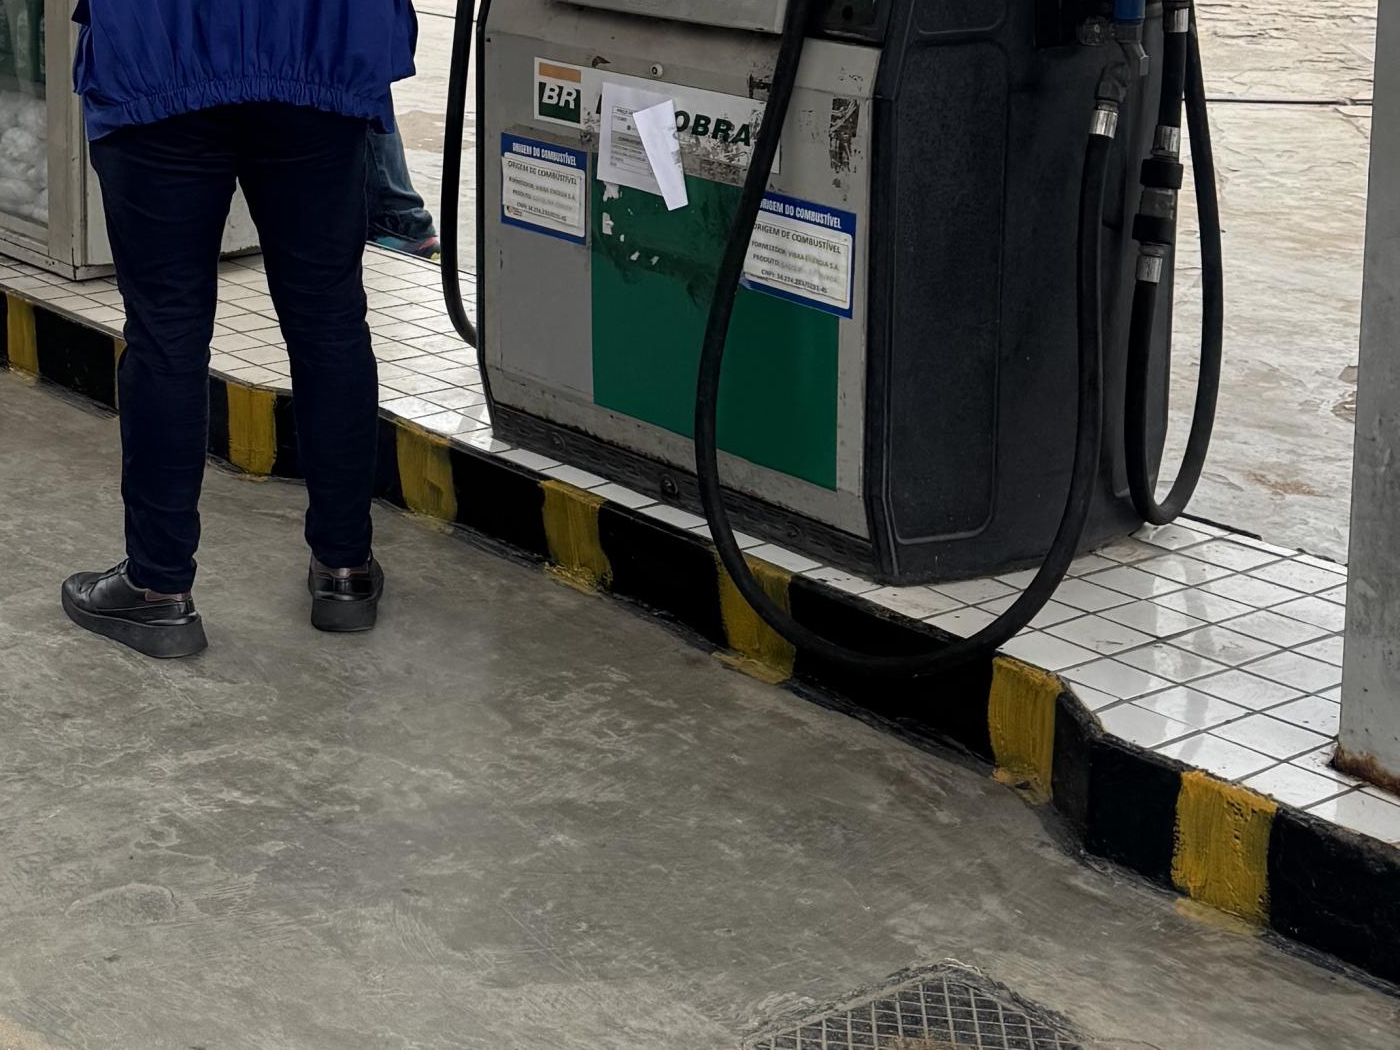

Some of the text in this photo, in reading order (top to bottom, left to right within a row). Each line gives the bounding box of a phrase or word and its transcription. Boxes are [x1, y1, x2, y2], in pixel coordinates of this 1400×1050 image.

[542, 85, 577, 109] BR
[512, 142, 533, 155] ORIGEM
[541, 149, 577, 166] COMBUSTÍVEL
[507, 160, 529, 172] ORIGEM
[537, 169, 577, 186] COMBUSTÍVEL
[785, 204, 794, 216] DO
[795, 207, 842, 230] COMBUSTÍVEL
[781, 229, 791, 240] DE
[791, 233, 842, 255] COMBUSTÍVEL
